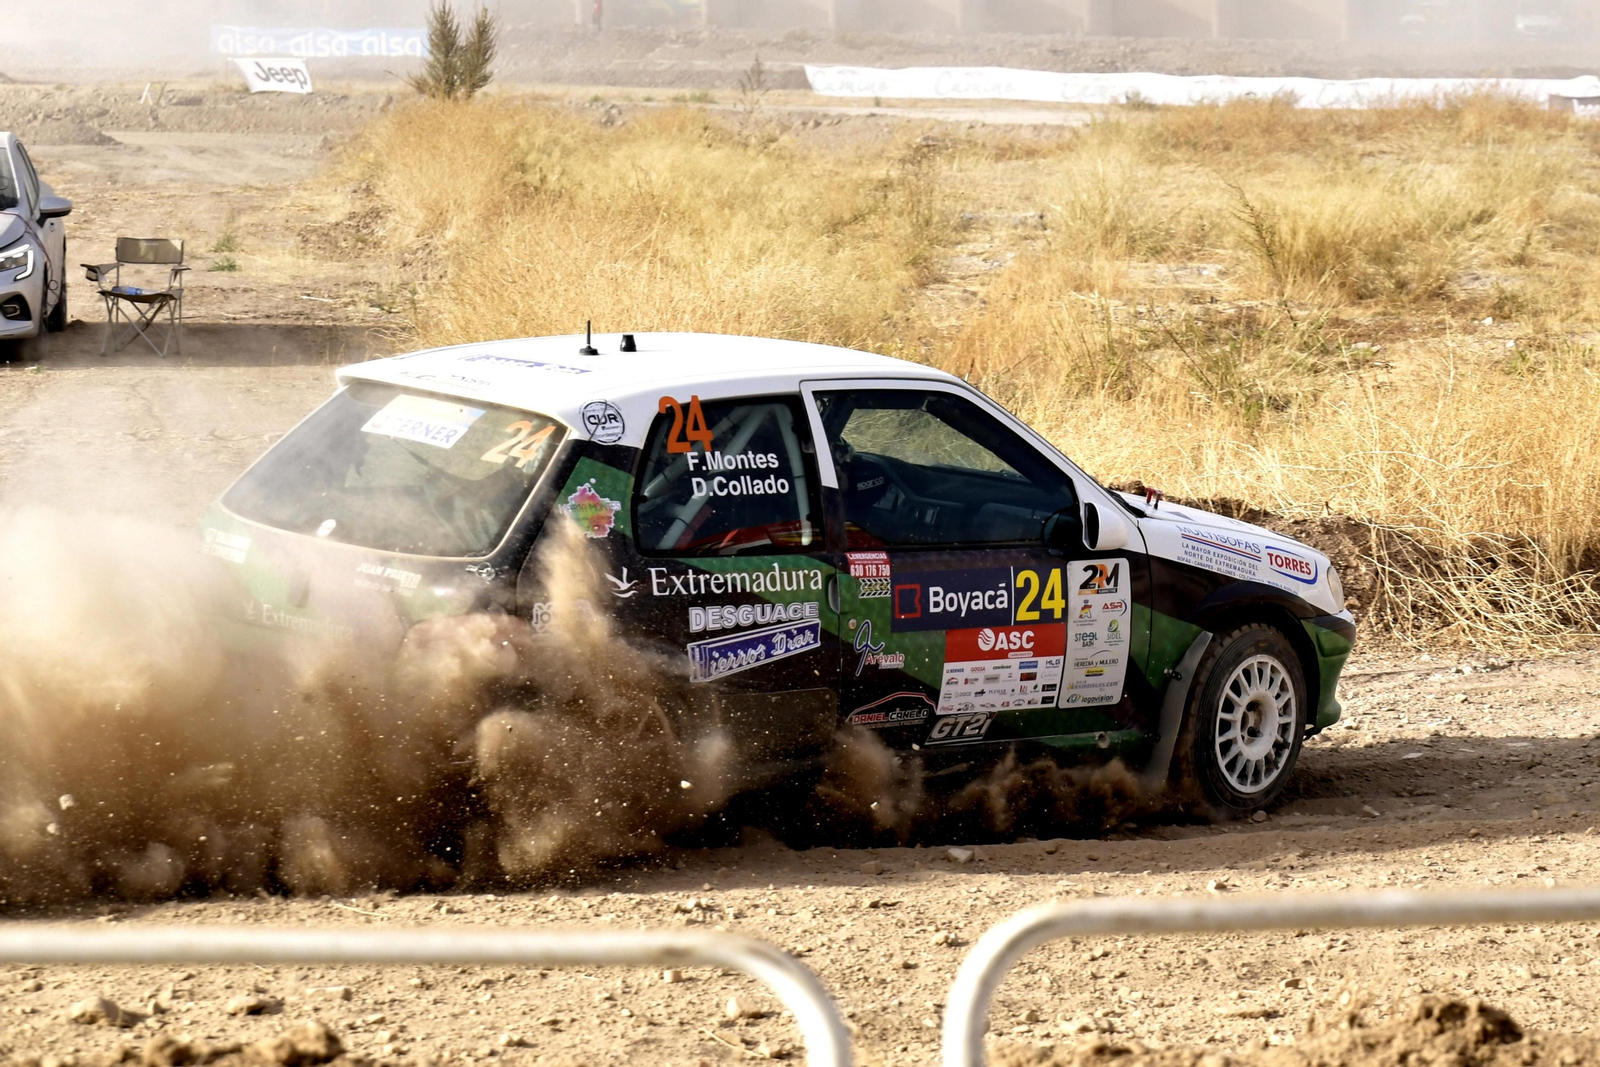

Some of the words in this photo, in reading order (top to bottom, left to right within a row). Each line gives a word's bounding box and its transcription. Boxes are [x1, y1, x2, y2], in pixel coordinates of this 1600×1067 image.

[218, 30, 275, 55] alsa
[290, 31, 348, 57] alsa
[362, 31, 421, 57] alsa
[254, 61, 309, 90] Jeep
[659, 395, 714, 454] 24
[481, 419, 557, 469] 24
[687, 451, 779, 471] F.Montes
[692, 474, 790, 497] D.Collado
[1176, 525, 1261, 554] MULTISOFAS
[1182, 542, 1190, 550] LA
[1191, 545, 1211, 556] MAYOR
[1248, 561, 1259, 571] DEL
[1184, 550, 1203, 561] NORTE
[1206, 556, 1213, 564] DE
[1215, 559, 1256, 577] EXTREMADURA
[1267, 553, 1312, 576] TORRES
[648, 563, 823, 597] Extremadura
[850, 564, 864, 577] 630
[865, 564, 877, 577] 176
[878, 564, 891, 577] 750
[1079, 563, 1120, 589] 2RM
[929, 583, 1008, 617] Boyacá
[1016, 568, 1066, 621] 24
[1102, 601, 1123, 611] ASR
[689, 602, 820, 633] DESGUACE
[994, 630, 1035, 651] ASC
[865, 652, 905, 665] Arévalo
[852, 713, 888, 725] DANIEL
